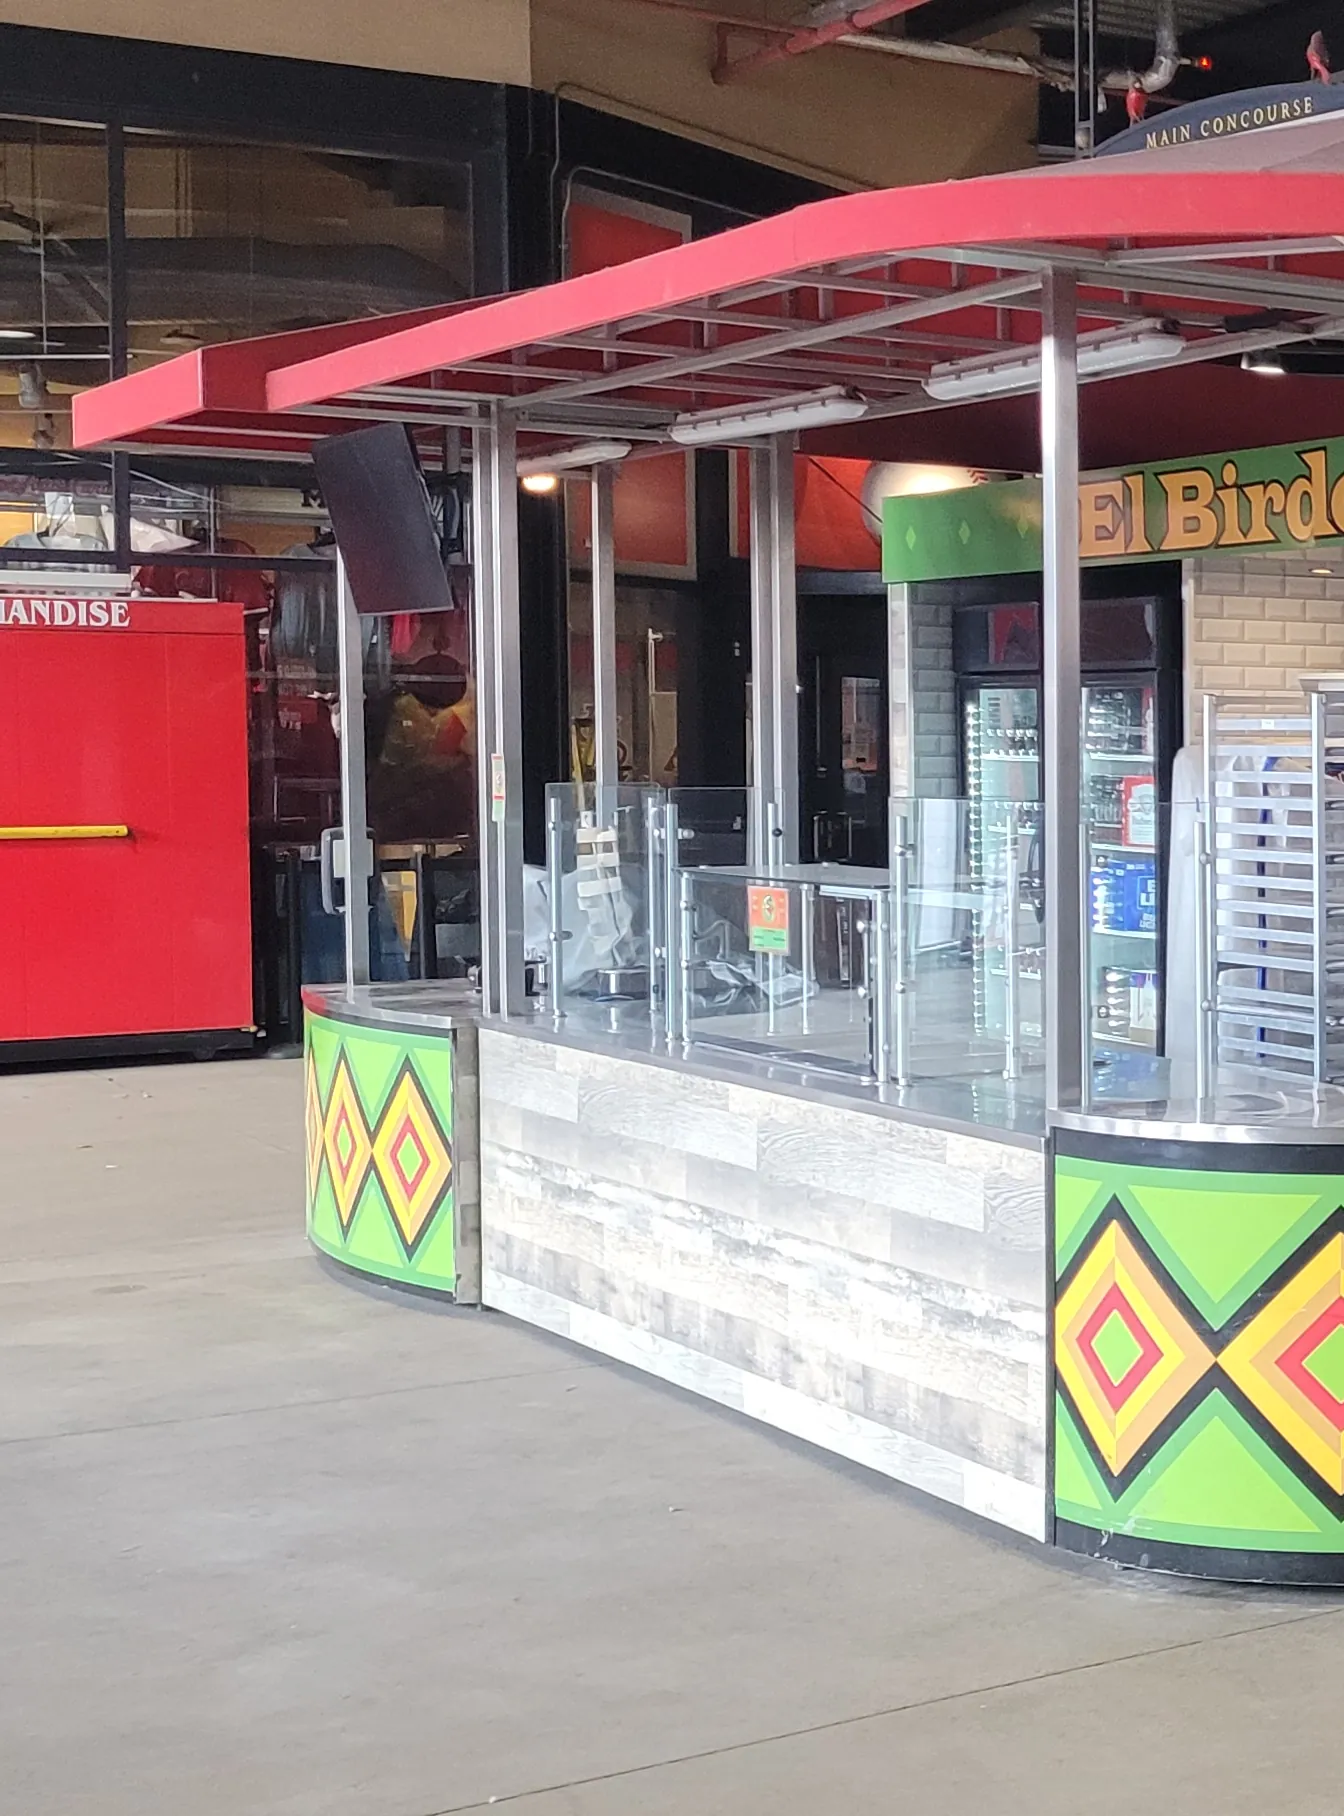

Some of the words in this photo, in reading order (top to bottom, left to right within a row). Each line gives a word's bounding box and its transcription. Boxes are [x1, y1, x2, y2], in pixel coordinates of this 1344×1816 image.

[1146, 124, 1190, 148] MAIN
[1201, 97, 1312, 137] CONCOURSE
[1078, 471, 1153, 558] El
